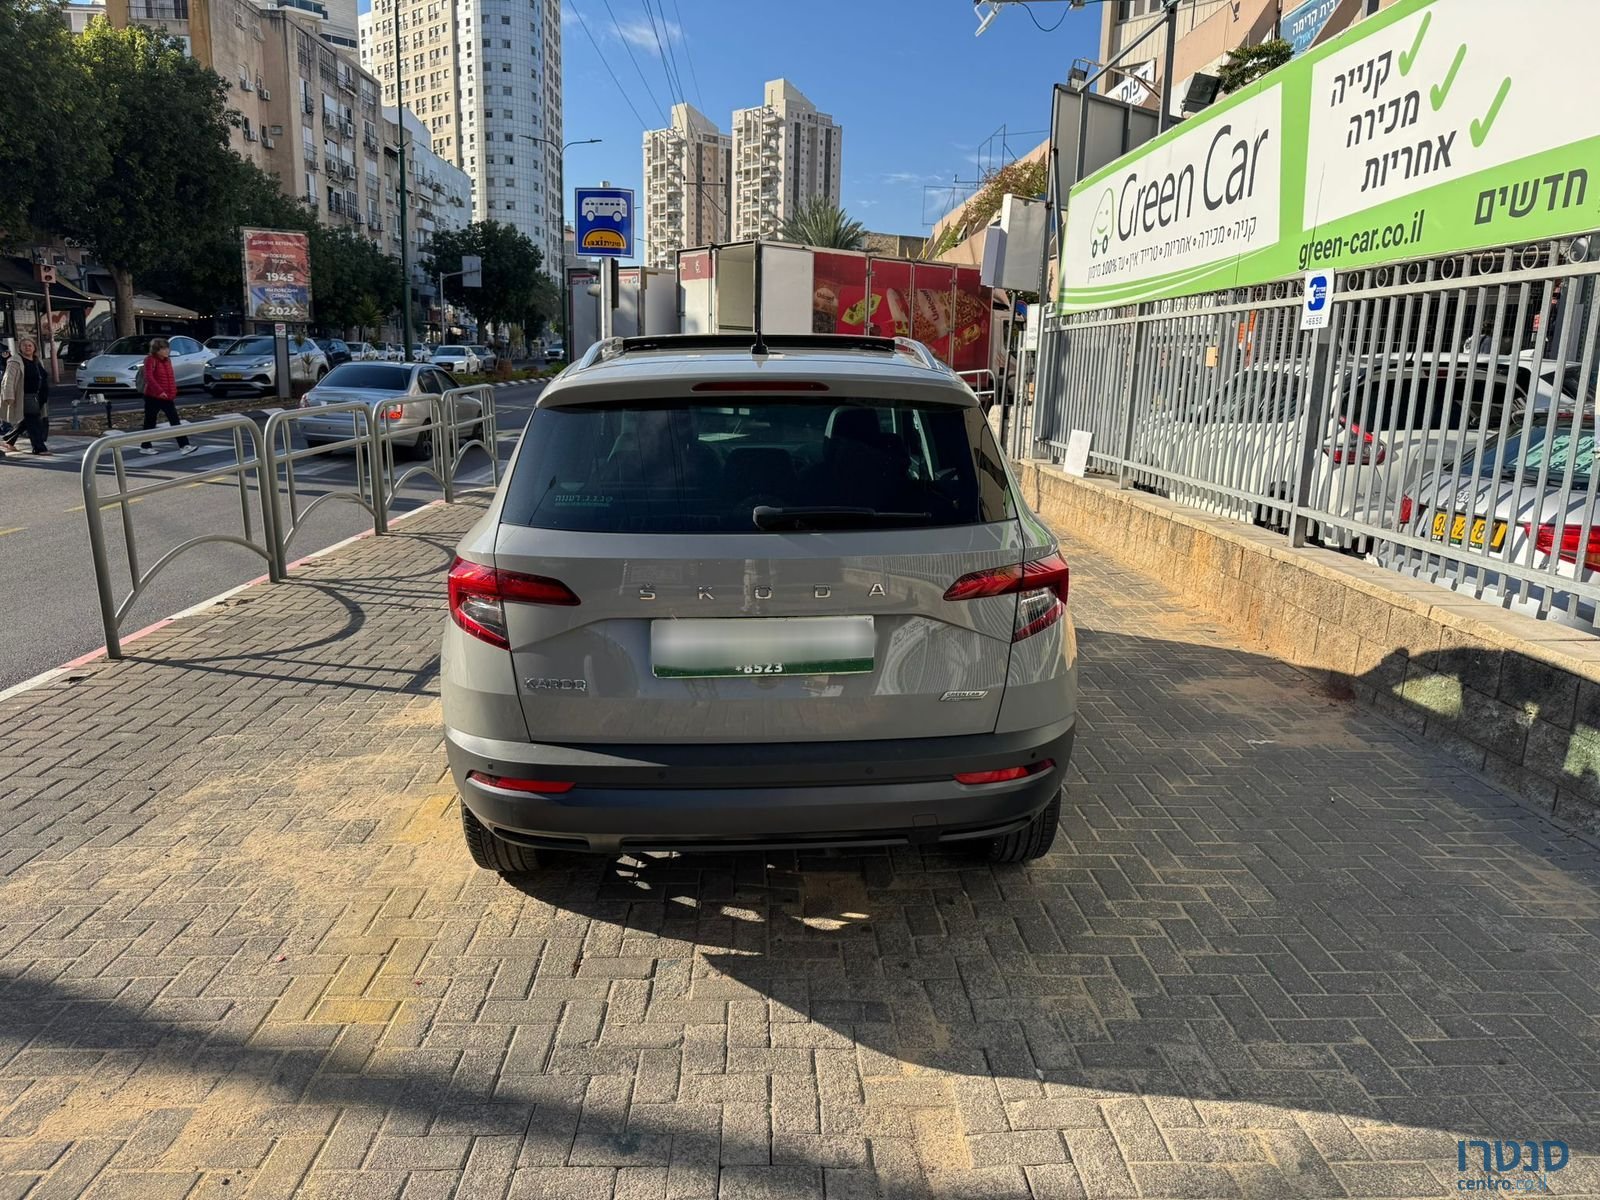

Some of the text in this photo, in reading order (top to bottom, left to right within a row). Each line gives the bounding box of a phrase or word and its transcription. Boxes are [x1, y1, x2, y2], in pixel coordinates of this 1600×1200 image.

[1292, 9, 1318, 36] קדימה
[1331, 50, 1392, 107] קנייה
[1346, 90, 1420, 148] מכירה
[1361, 130, 1457, 192] אחריות
[1118, 124, 1269, 241] Green Car
[1474, 168, 1588, 225] חדשים
[587, 236, 603, 246] taxi
[1197, 225, 1225, 249] מכירה
[1232, 216, 1257, 243] קניה
[1298, 209, 1425, 270] green-car.co.il
[266, 272, 294, 282] 1945
[269, 307, 299, 316] 2024
[524, 677, 587, 691] KAROQ
